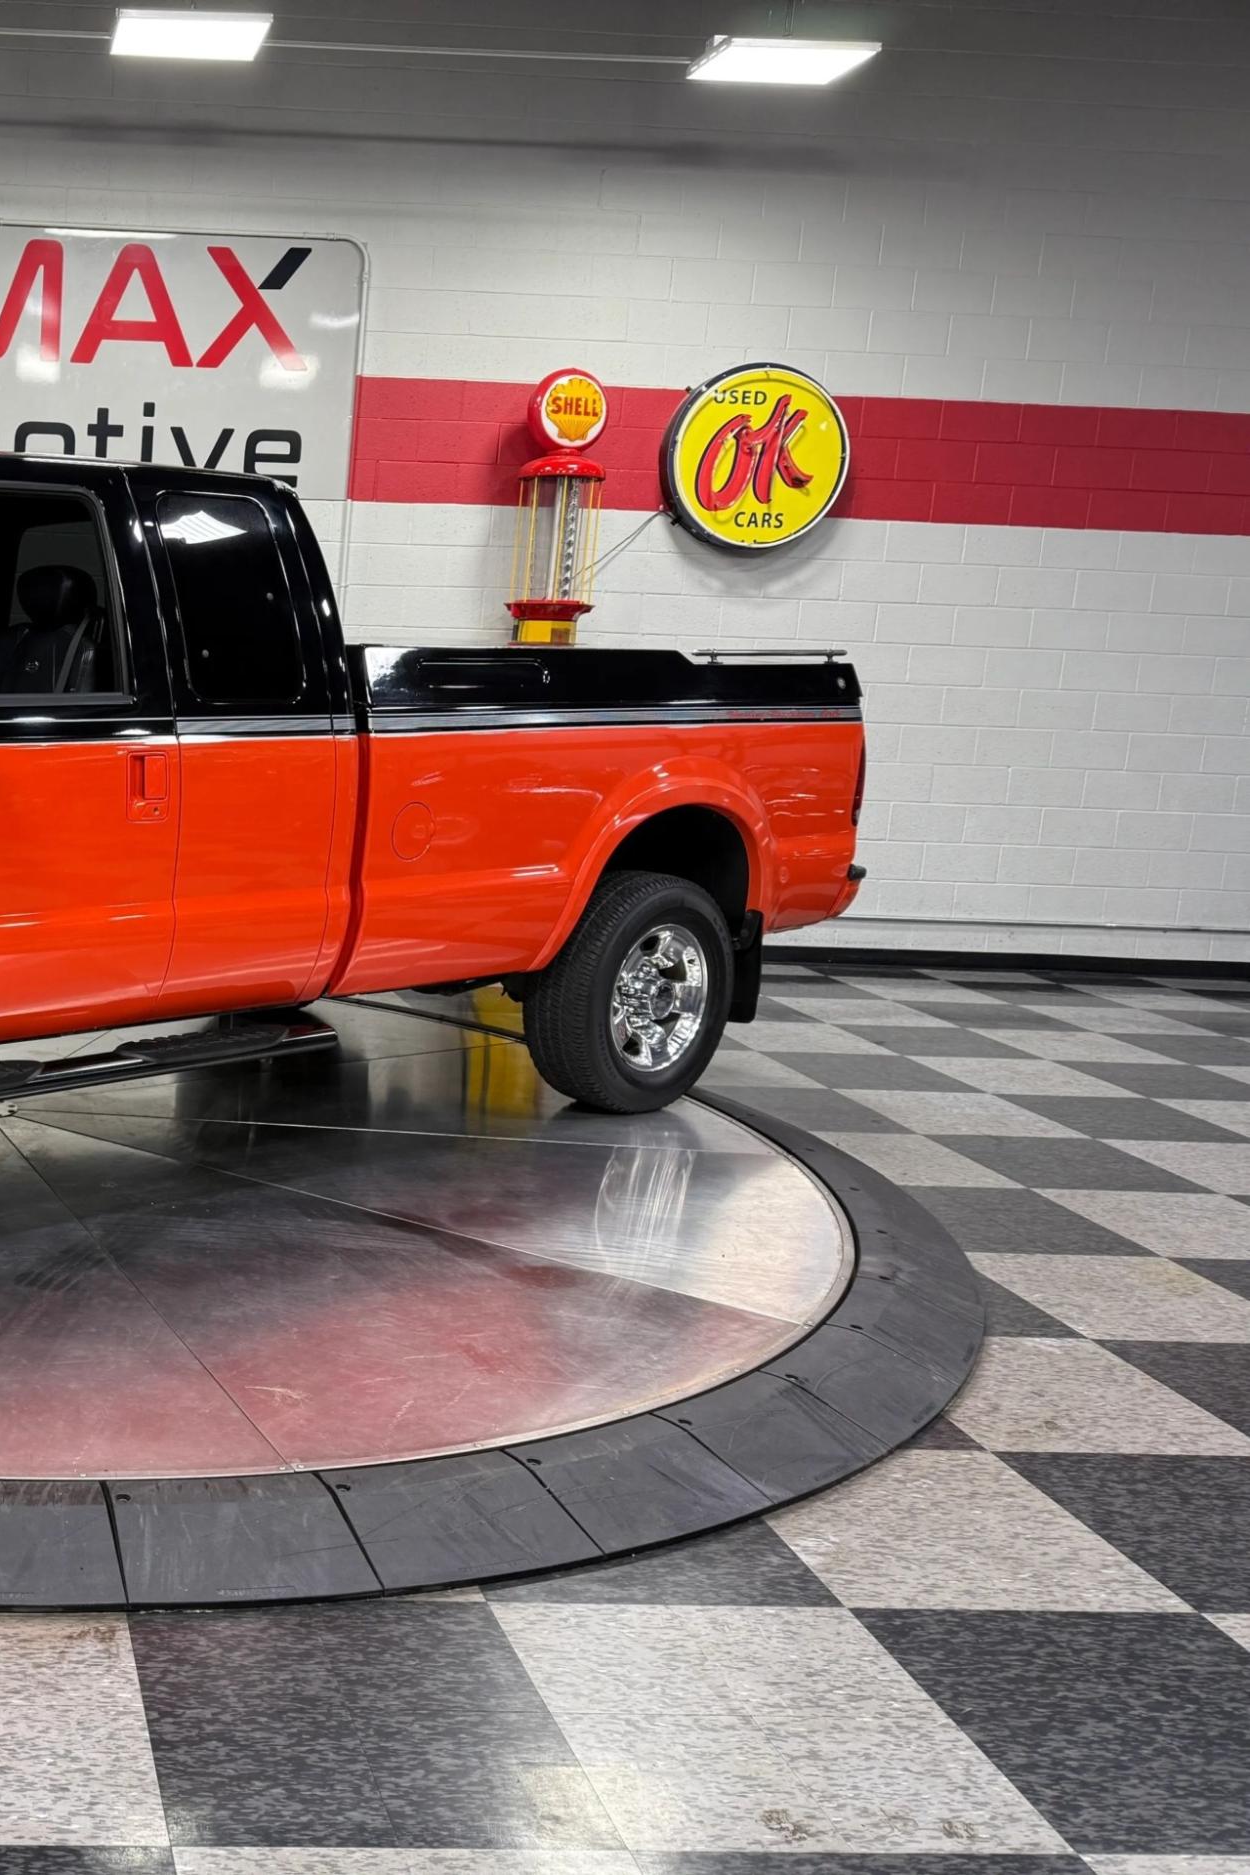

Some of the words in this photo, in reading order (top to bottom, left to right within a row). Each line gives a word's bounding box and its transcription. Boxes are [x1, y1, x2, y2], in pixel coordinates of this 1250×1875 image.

[550, 396, 599, 417] SHELL
[713, 388, 768, 406] USED
[696, 393, 814, 512] OK
[733, 511, 785, 530] CARS
